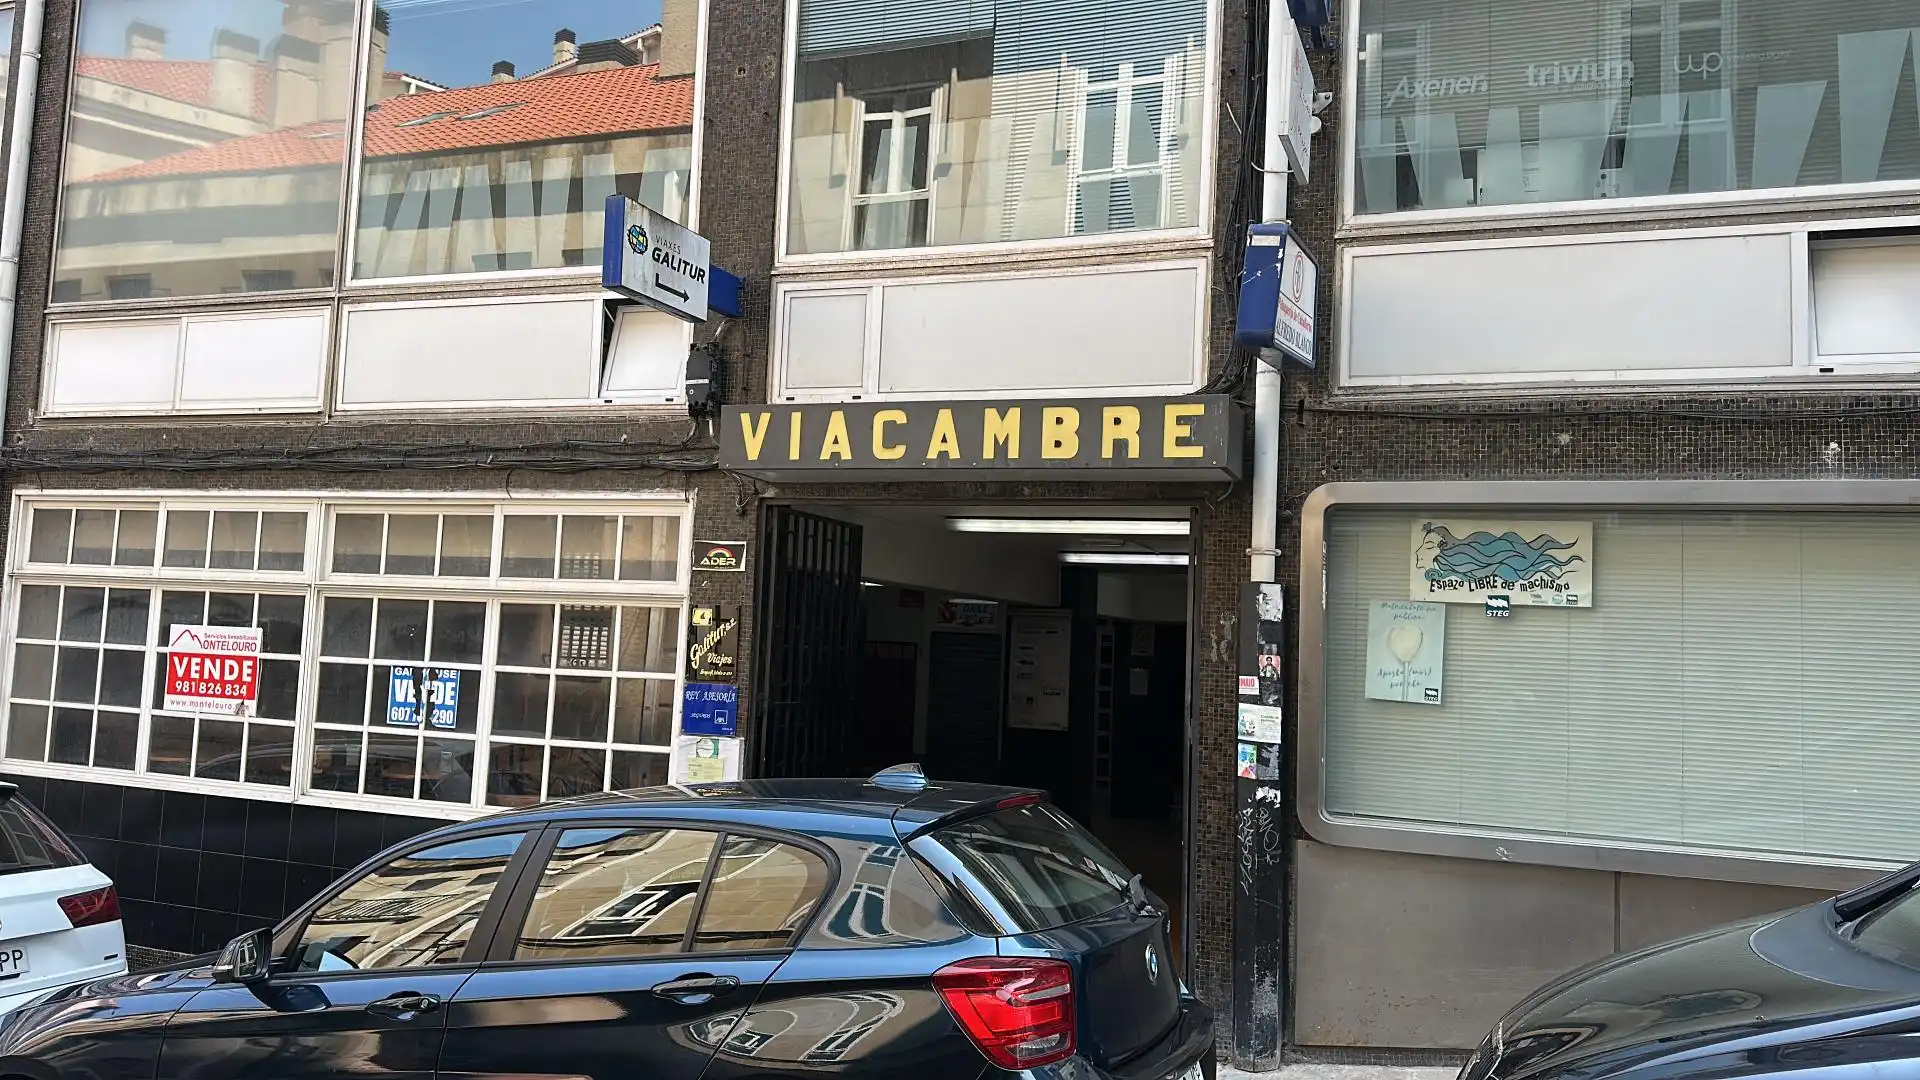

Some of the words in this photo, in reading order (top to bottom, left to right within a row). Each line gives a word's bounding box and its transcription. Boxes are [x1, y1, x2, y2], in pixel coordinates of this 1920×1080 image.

[1527, 59, 1635, 86] trivium
[655, 234, 681, 255] VIAXES
[651, 247, 706, 285] GALITUR
[740, 404, 1205, 460] VIACAMBRE
[700, 557, 736, 566] ADER
[1429, 578, 1464, 592] Espazo
[1468, 574, 1498, 592] LIBRE
[1501, 579, 1515, 591] de
[1520, 575, 1570, 593] machismo
[172, 656, 254, 683] VENDE
[707, 652, 733, 667] Viajes
[175, 680, 195, 693] 981
[199, 682, 222, 695] 826
[225, 683, 247, 697] 834
[685, 690, 701, 701] REY
